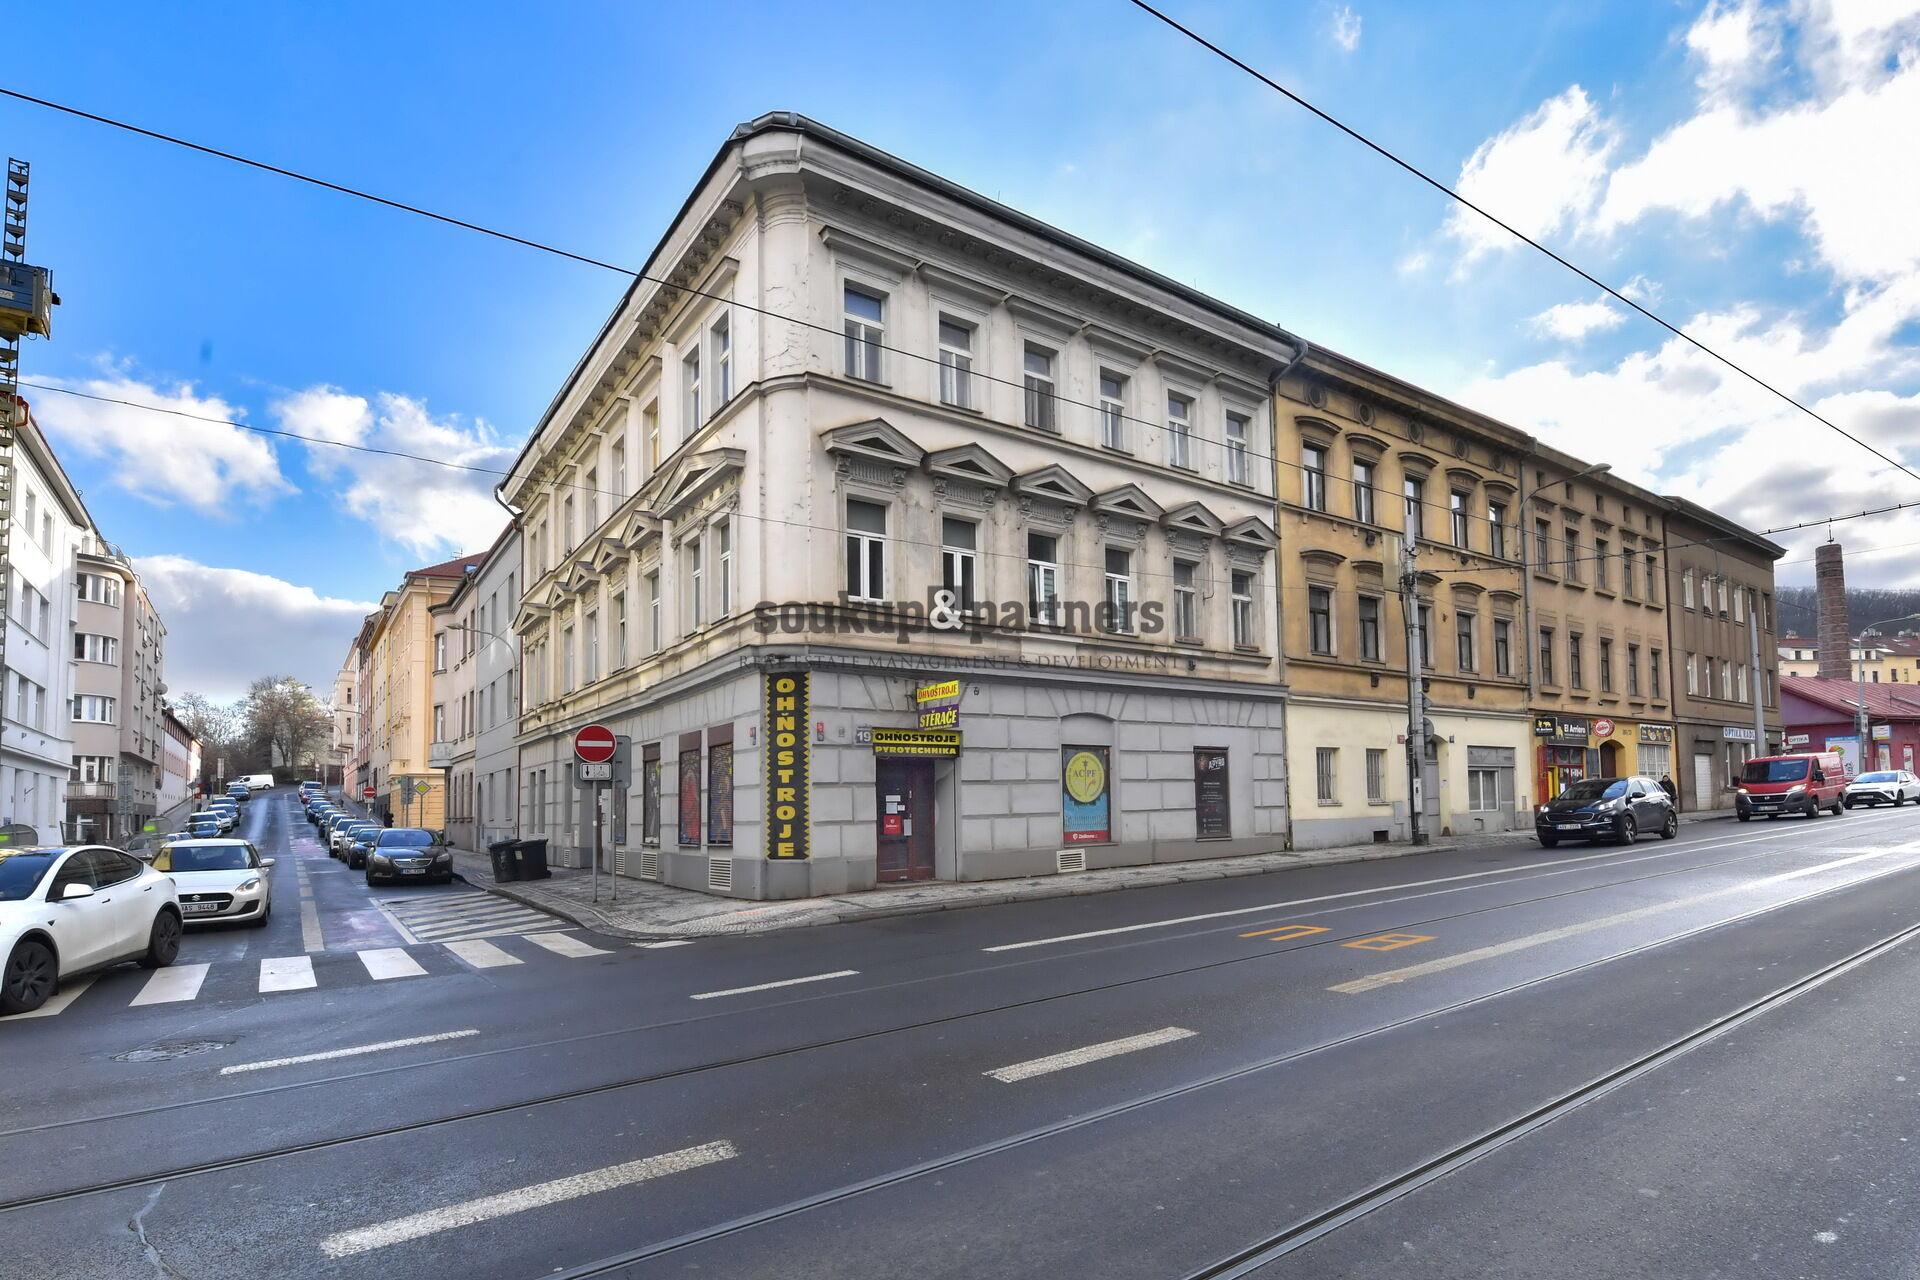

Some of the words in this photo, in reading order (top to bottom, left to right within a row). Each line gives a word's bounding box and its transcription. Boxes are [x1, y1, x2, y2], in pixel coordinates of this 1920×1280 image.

[919, 706, 958, 728] STĚRAČE
[857, 731, 871, 742] 19
[875, 730, 957, 743] OHŇOSTROJE
[1789, 736, 1809, 744] OPTIKA
[875, 746, 957, 755] PYROTECHNIKA
[776, 678, 796, 857] OHŇOSTROJE
